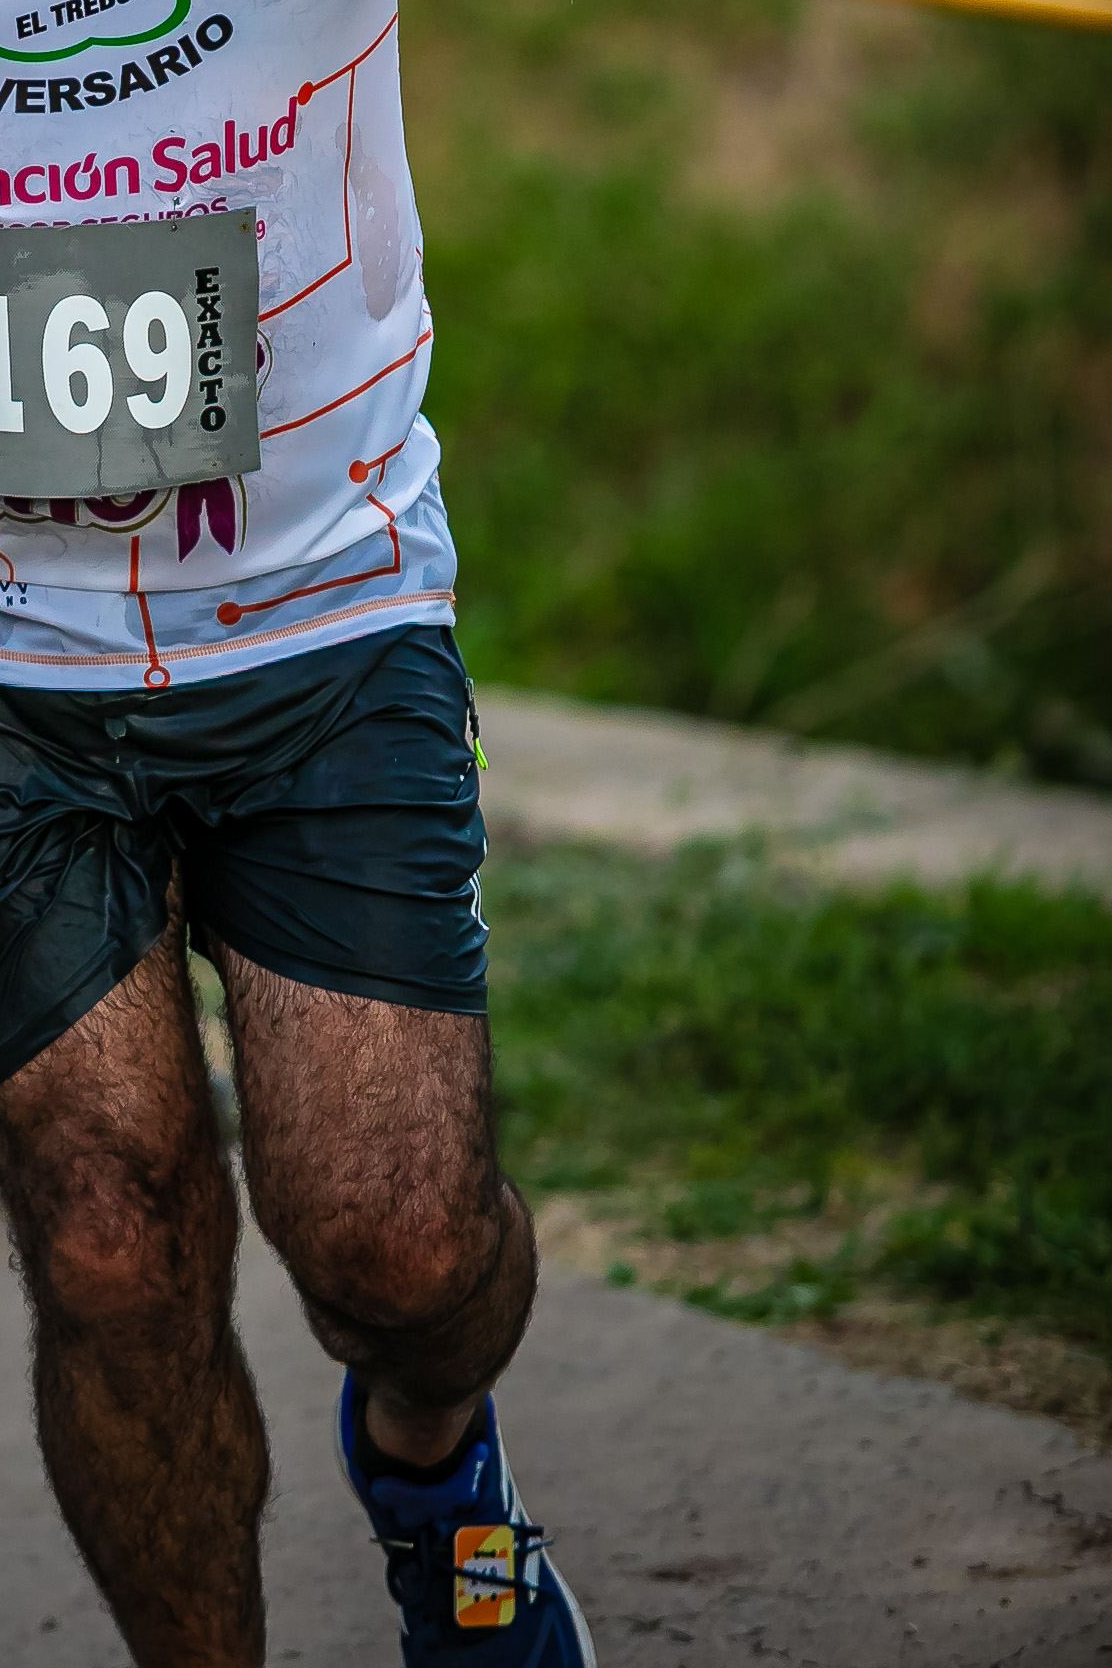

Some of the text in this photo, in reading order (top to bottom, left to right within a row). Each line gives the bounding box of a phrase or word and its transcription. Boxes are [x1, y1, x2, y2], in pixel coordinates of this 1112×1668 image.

[15, 8, 47, 40] EL
[151, 96, 298, 193] Salud
[194, 265, 227, 433] EXACTO
